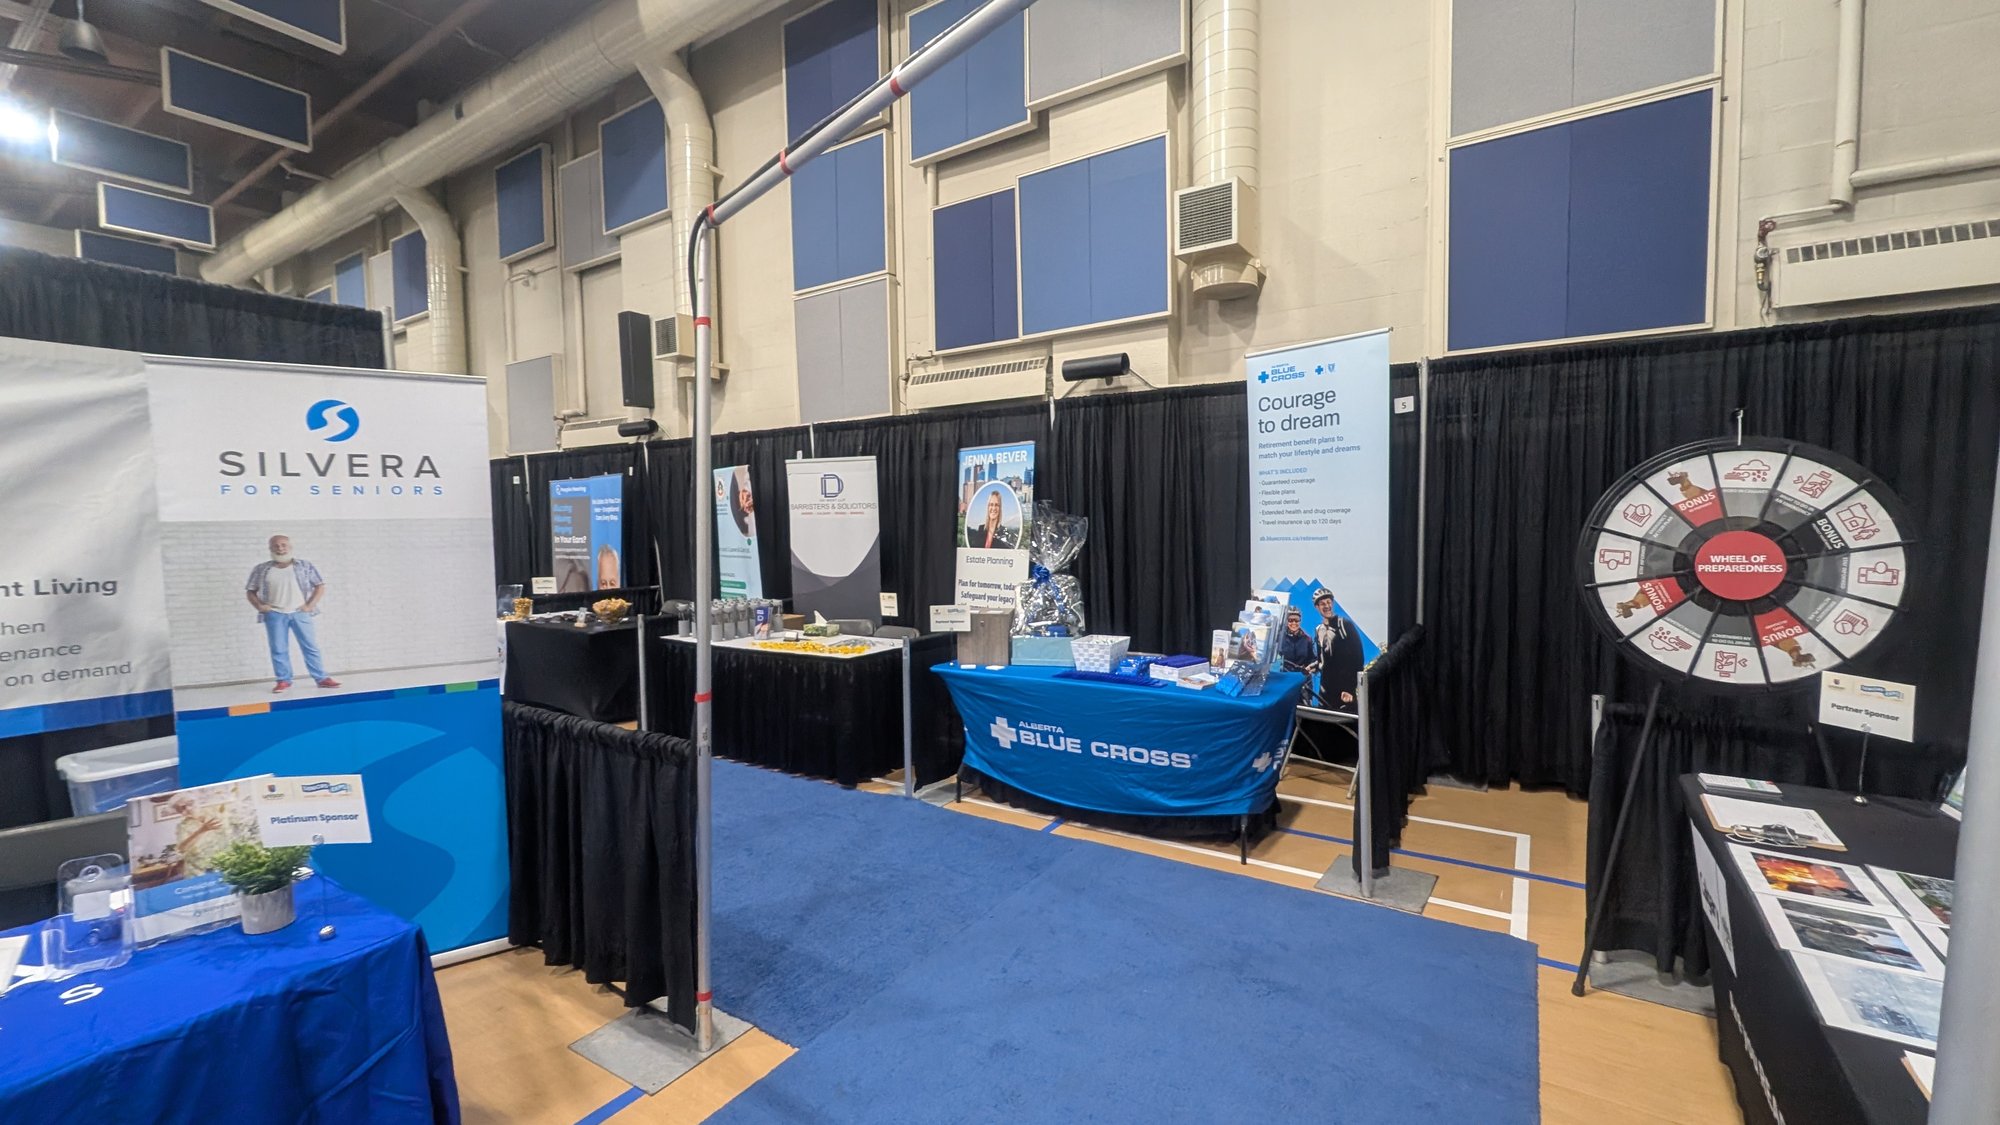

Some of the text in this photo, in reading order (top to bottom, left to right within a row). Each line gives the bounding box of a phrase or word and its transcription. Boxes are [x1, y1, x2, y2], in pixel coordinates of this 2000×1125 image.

[1271, 366, 1296, 375] BLUE
[1271, 371, 1305, 382] CROSS
[1258, 390, 1336, 412] Courage
[1258, 413, 1340, 434] to dream
[1259, 440, 1292, 449] Retirement
[1293, 437, 1316, 446] benefit
[1318, 437, 1335, 445] plans
[963, 450, 1028, 465] JENNA BEVER
[1294, 449, 1320, 457] lifestyle
[1321, 446, 1333, 454] and
[219, 451, 440, 478] SILVERA
[220, 485, 443, 496] FOR SENIORS
[837, 502, 877, 510] SOLICITORS
[1679, 491, 1716, 511] BONUS
[1816, 518, 1845, 549] BONUS
[966, 556, 1014, 567] Estate Planning
[1710, 555, 1767, 563] WHEEL OF
[1698, 564, 1783, 573] PREPAREDNESS
[34, 578, 118, 596] Living
[958, 579, 968, 587] Plan
[969, 580, 977, 588] for
[977, 581, 1003, 591] tomorrow,
[961, 591, 1015, 605] Safeguard your legacy
[1643, 582, 1665, 611] BONUS
[1762, 625, 1803, 644] BONUS
[5, 661, 131, 687] on demand
[1831, 703, 1899, 721] Partner Sponsor
[1019, 720, 1064, 734] ALBERTA
[1019, 730, 1193, 768] BLUE CROSS
[270, 814, 359, 824] Platinum Sponsor
